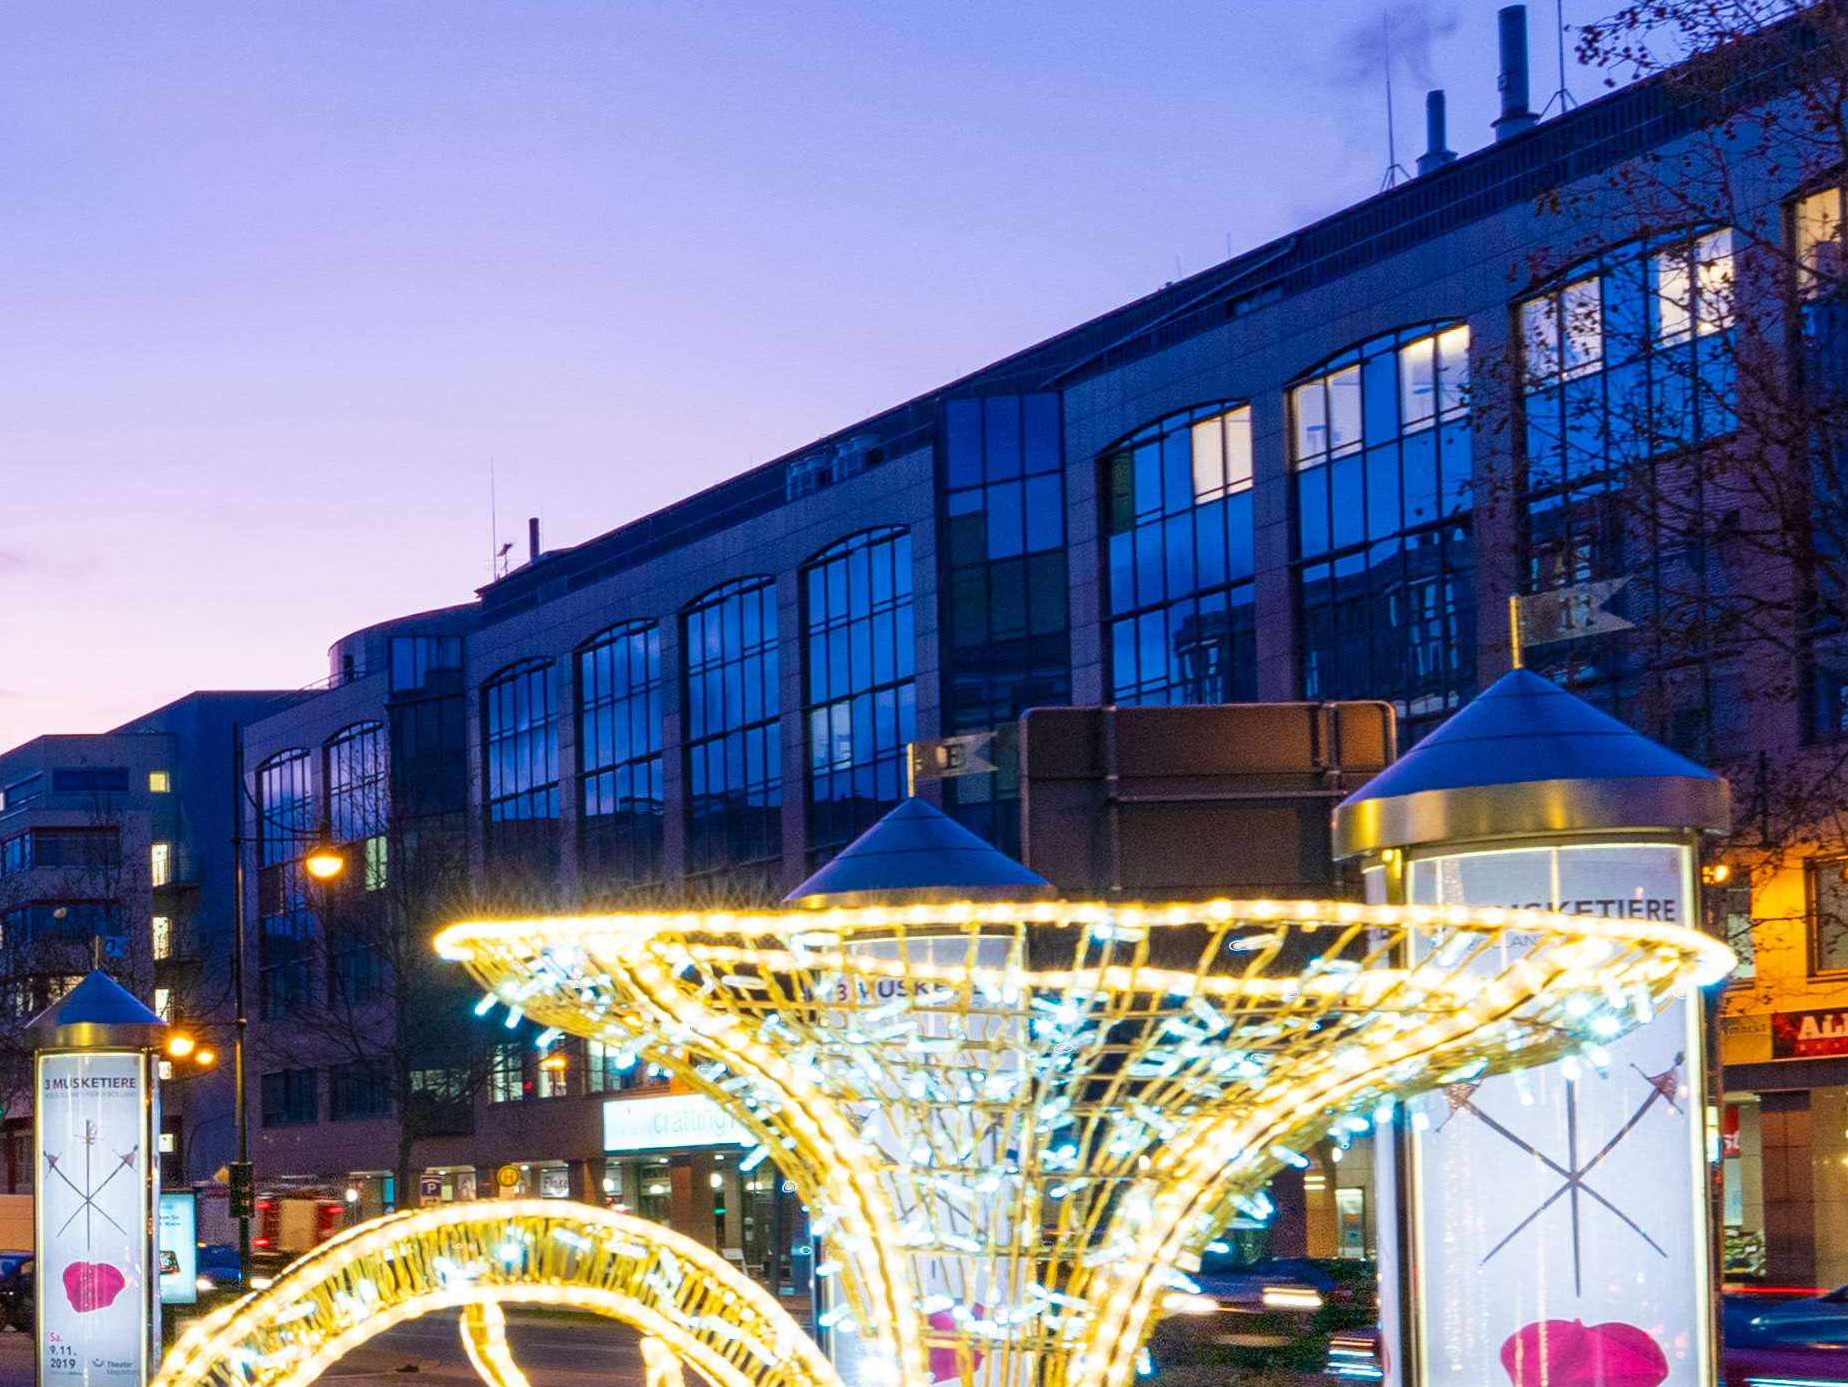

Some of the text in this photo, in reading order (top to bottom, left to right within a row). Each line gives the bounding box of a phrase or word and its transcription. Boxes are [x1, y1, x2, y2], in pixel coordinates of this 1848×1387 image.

[44, 1079, 51, 1090] 3
[53, 1077, 137, 1090] MUSKETIERE
[654, 1104, 726, 1137] crafting
[50, 1332, 63, 1342] Sa.
[50, 1345, 77, 1356] 9.11.
[50, 1358, 76, 1369] 2019
